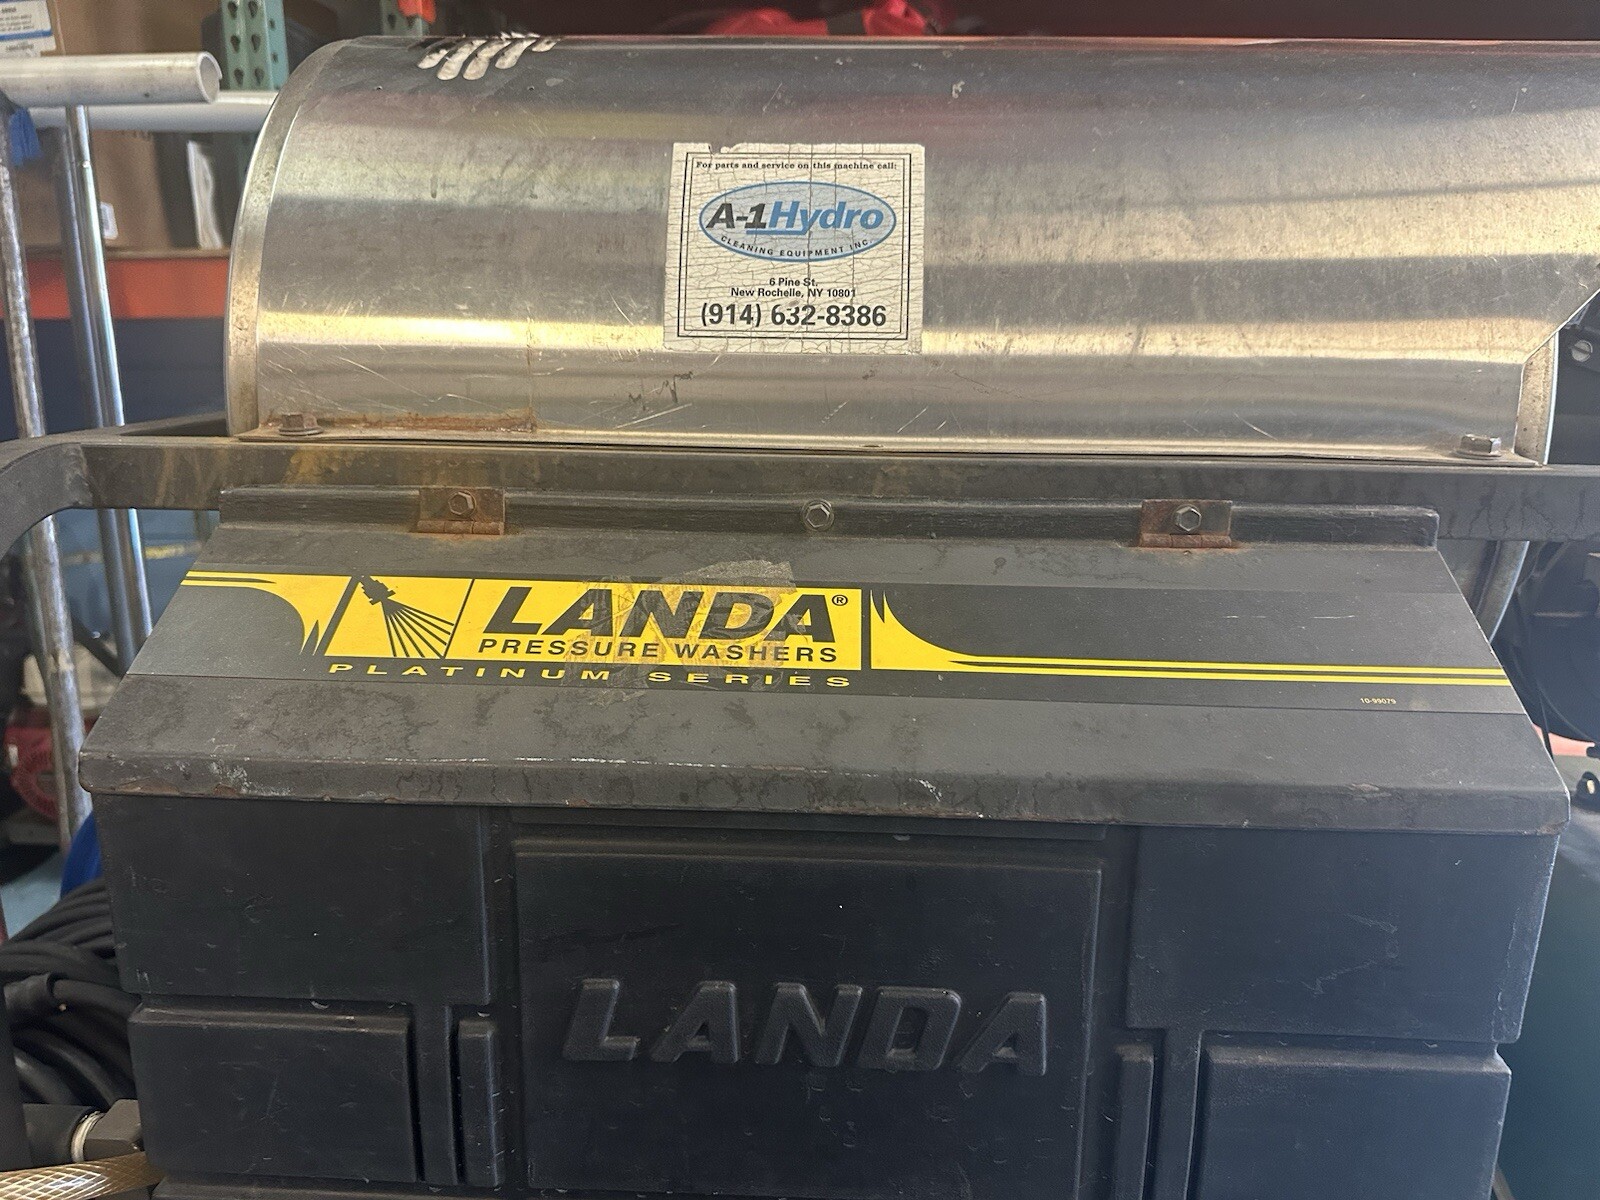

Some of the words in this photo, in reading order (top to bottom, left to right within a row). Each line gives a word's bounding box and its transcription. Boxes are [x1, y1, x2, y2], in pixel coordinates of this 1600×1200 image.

[696, 161, 712, 169] For
[715, 162, 739, 170] parts
[741, 161, 759, 169] and
[877, 162, 897, 170] call:
[721, 235, 774, 256] CLEANING
[779, 246, 844, 257] EQUIPMENT
[731, 288, 755, 297] New
[757, 288, 804, 299] Rochelle,
[808, 289, 823, 298] NY
[827, 289, 856, 298] 10801
[769, 279, 777, 287] 6
[778, 278, 801, 287] Pine
[803, 278, 818, 287] St.
[701, 303, 762, 327] (914)
[771, 304, 887, 327] 632-8386
[478, 638, 662, 658] PRESSURE
[676, 644, 838, 663] WASHERS
[328, 663, 611, 681] PLATINUM
[648, 670, 851, 689] SERIES
[1360, 697, 1397, 705] 10-99079
[562, 978, 1047, 1077] LANDA
